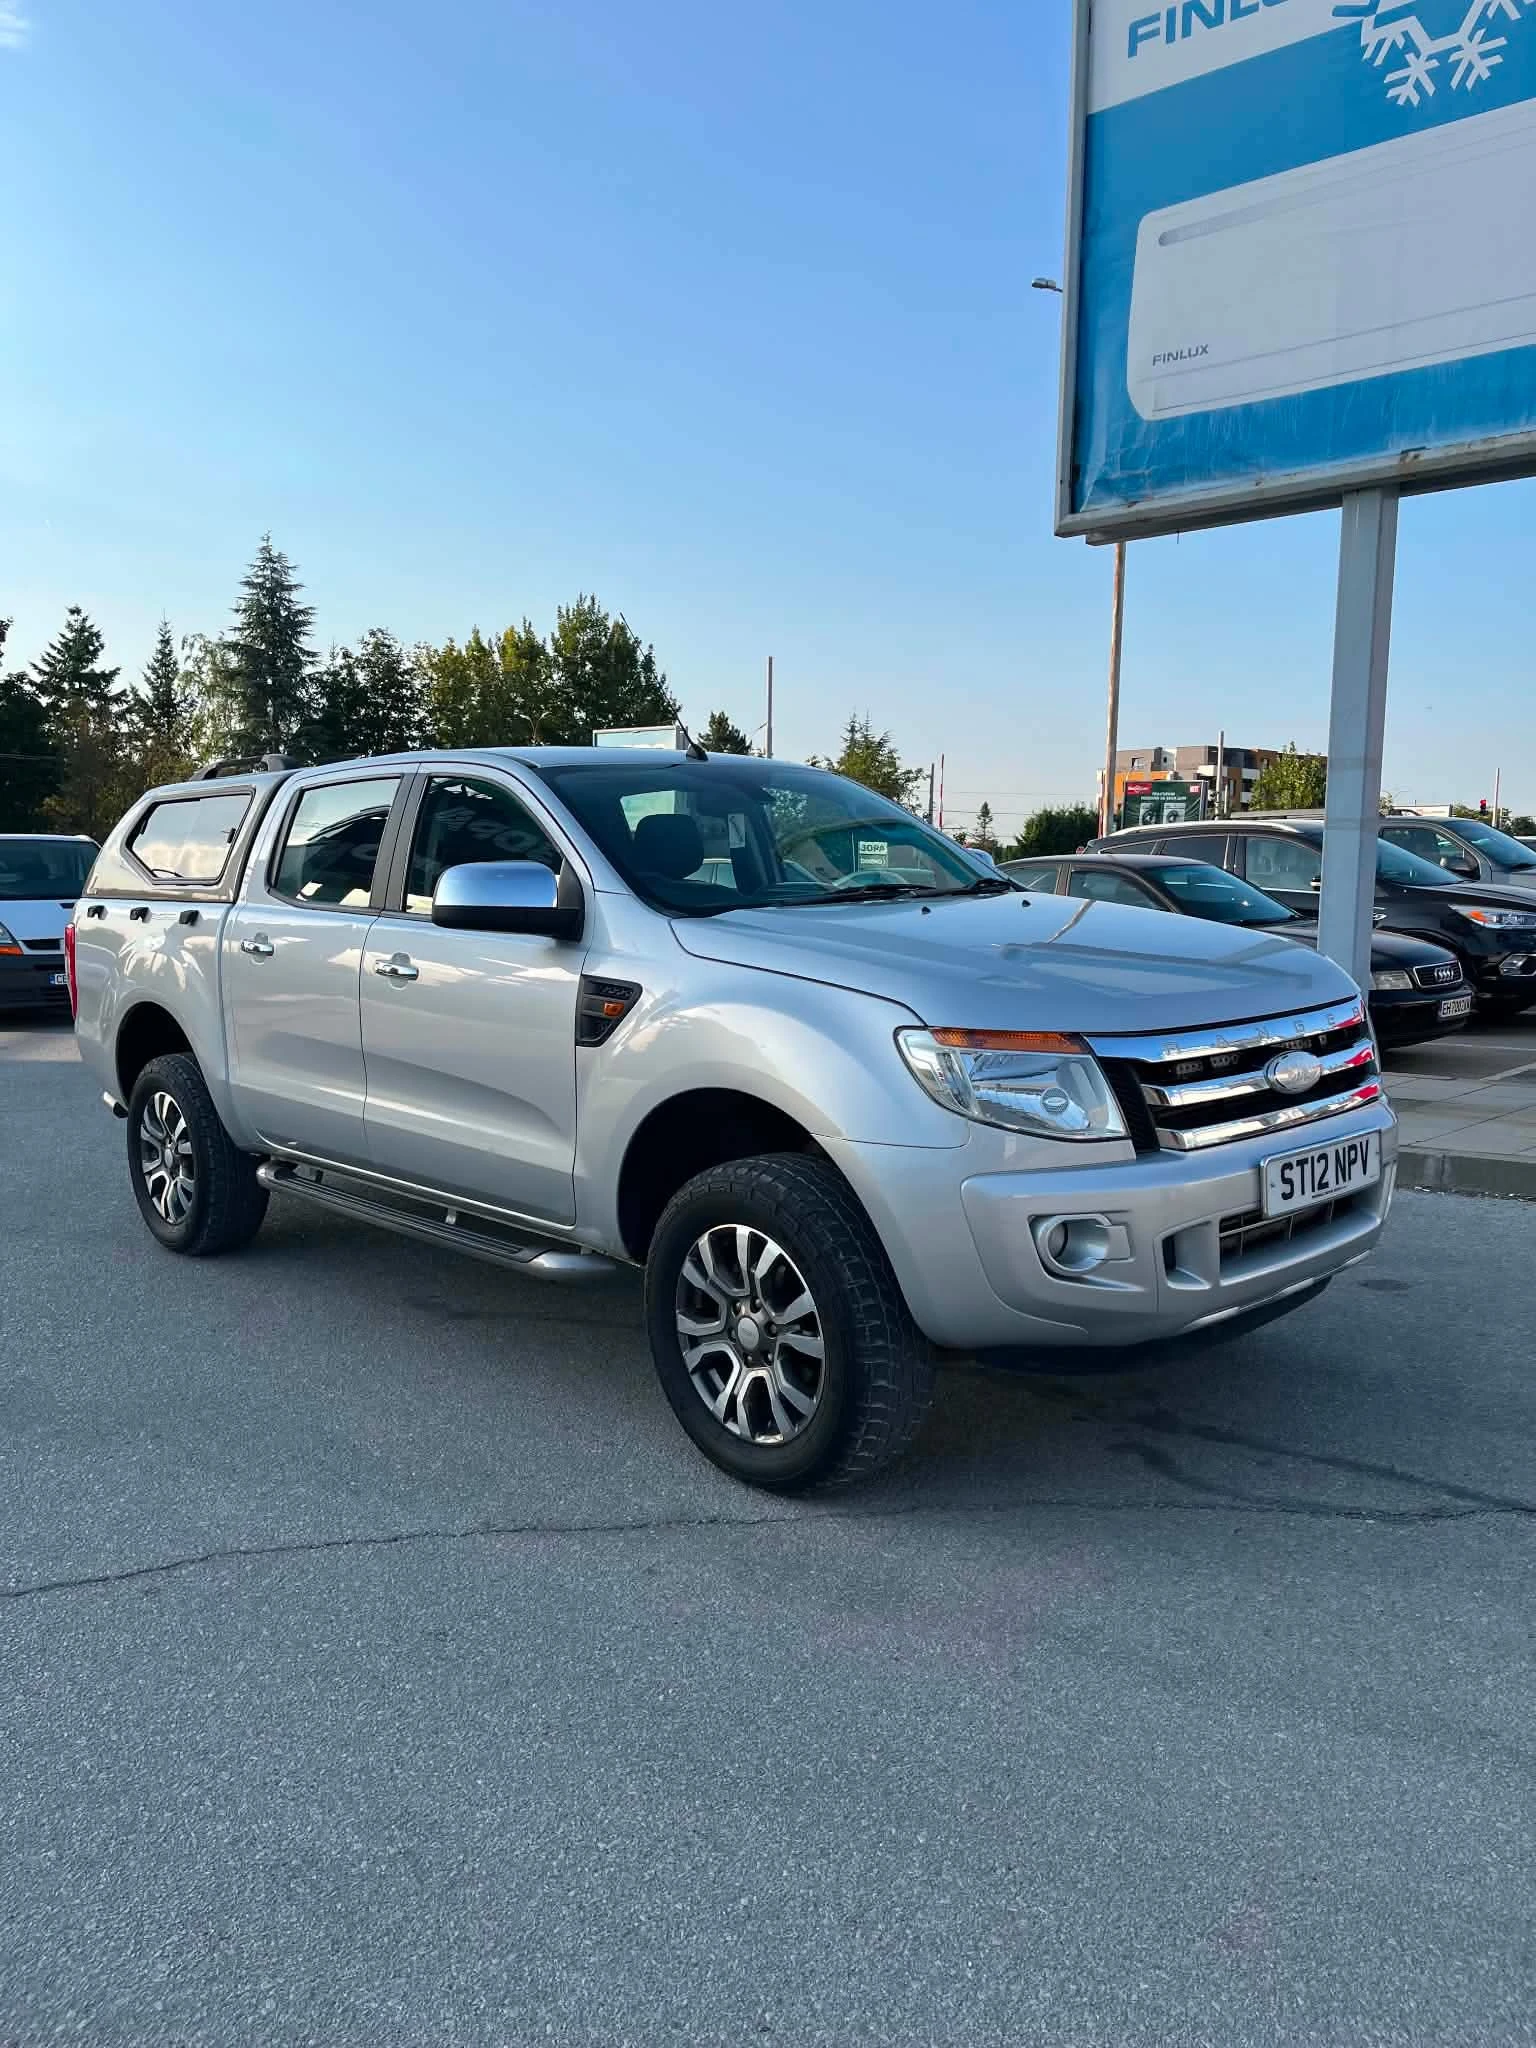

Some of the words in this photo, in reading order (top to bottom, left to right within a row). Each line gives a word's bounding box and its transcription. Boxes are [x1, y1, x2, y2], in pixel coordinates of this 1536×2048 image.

[1127, 0, 1289, 59] FINL
[1152, 343, 1209, 367] FINLUX
[1280, 1152, 1329, 1201] ST12
[1334, 1139, 1369, 1186] NPV
